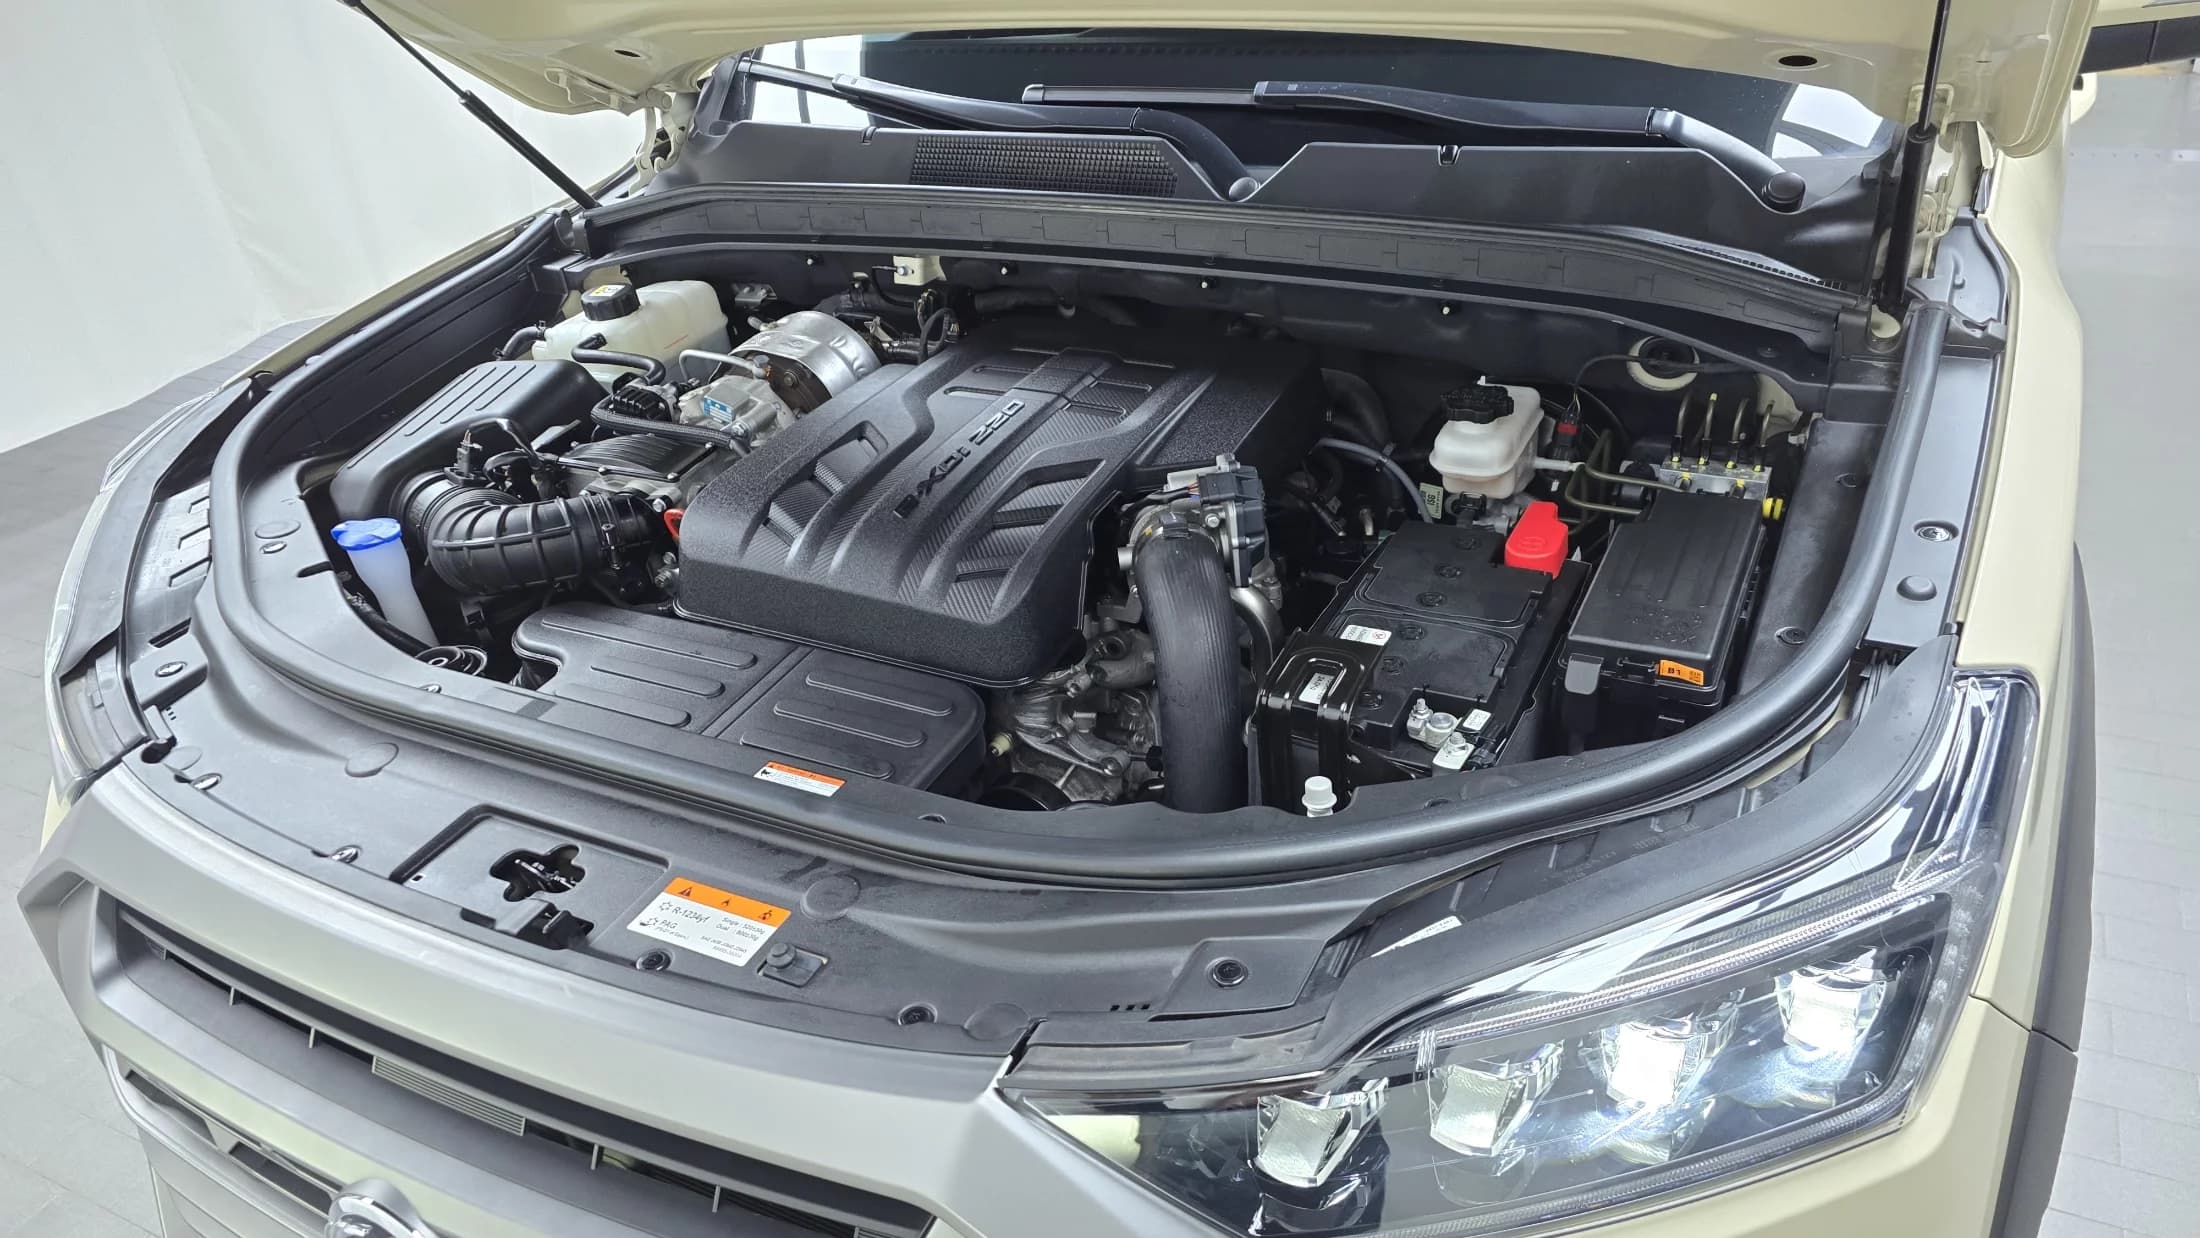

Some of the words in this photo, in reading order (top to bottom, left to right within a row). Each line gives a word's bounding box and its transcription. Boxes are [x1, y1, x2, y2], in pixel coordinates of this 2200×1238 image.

[968, 399, 1026, 446] 220
[660, 919, 678, 929] PAG
[671, 906, 711, 924] R-1234yf
